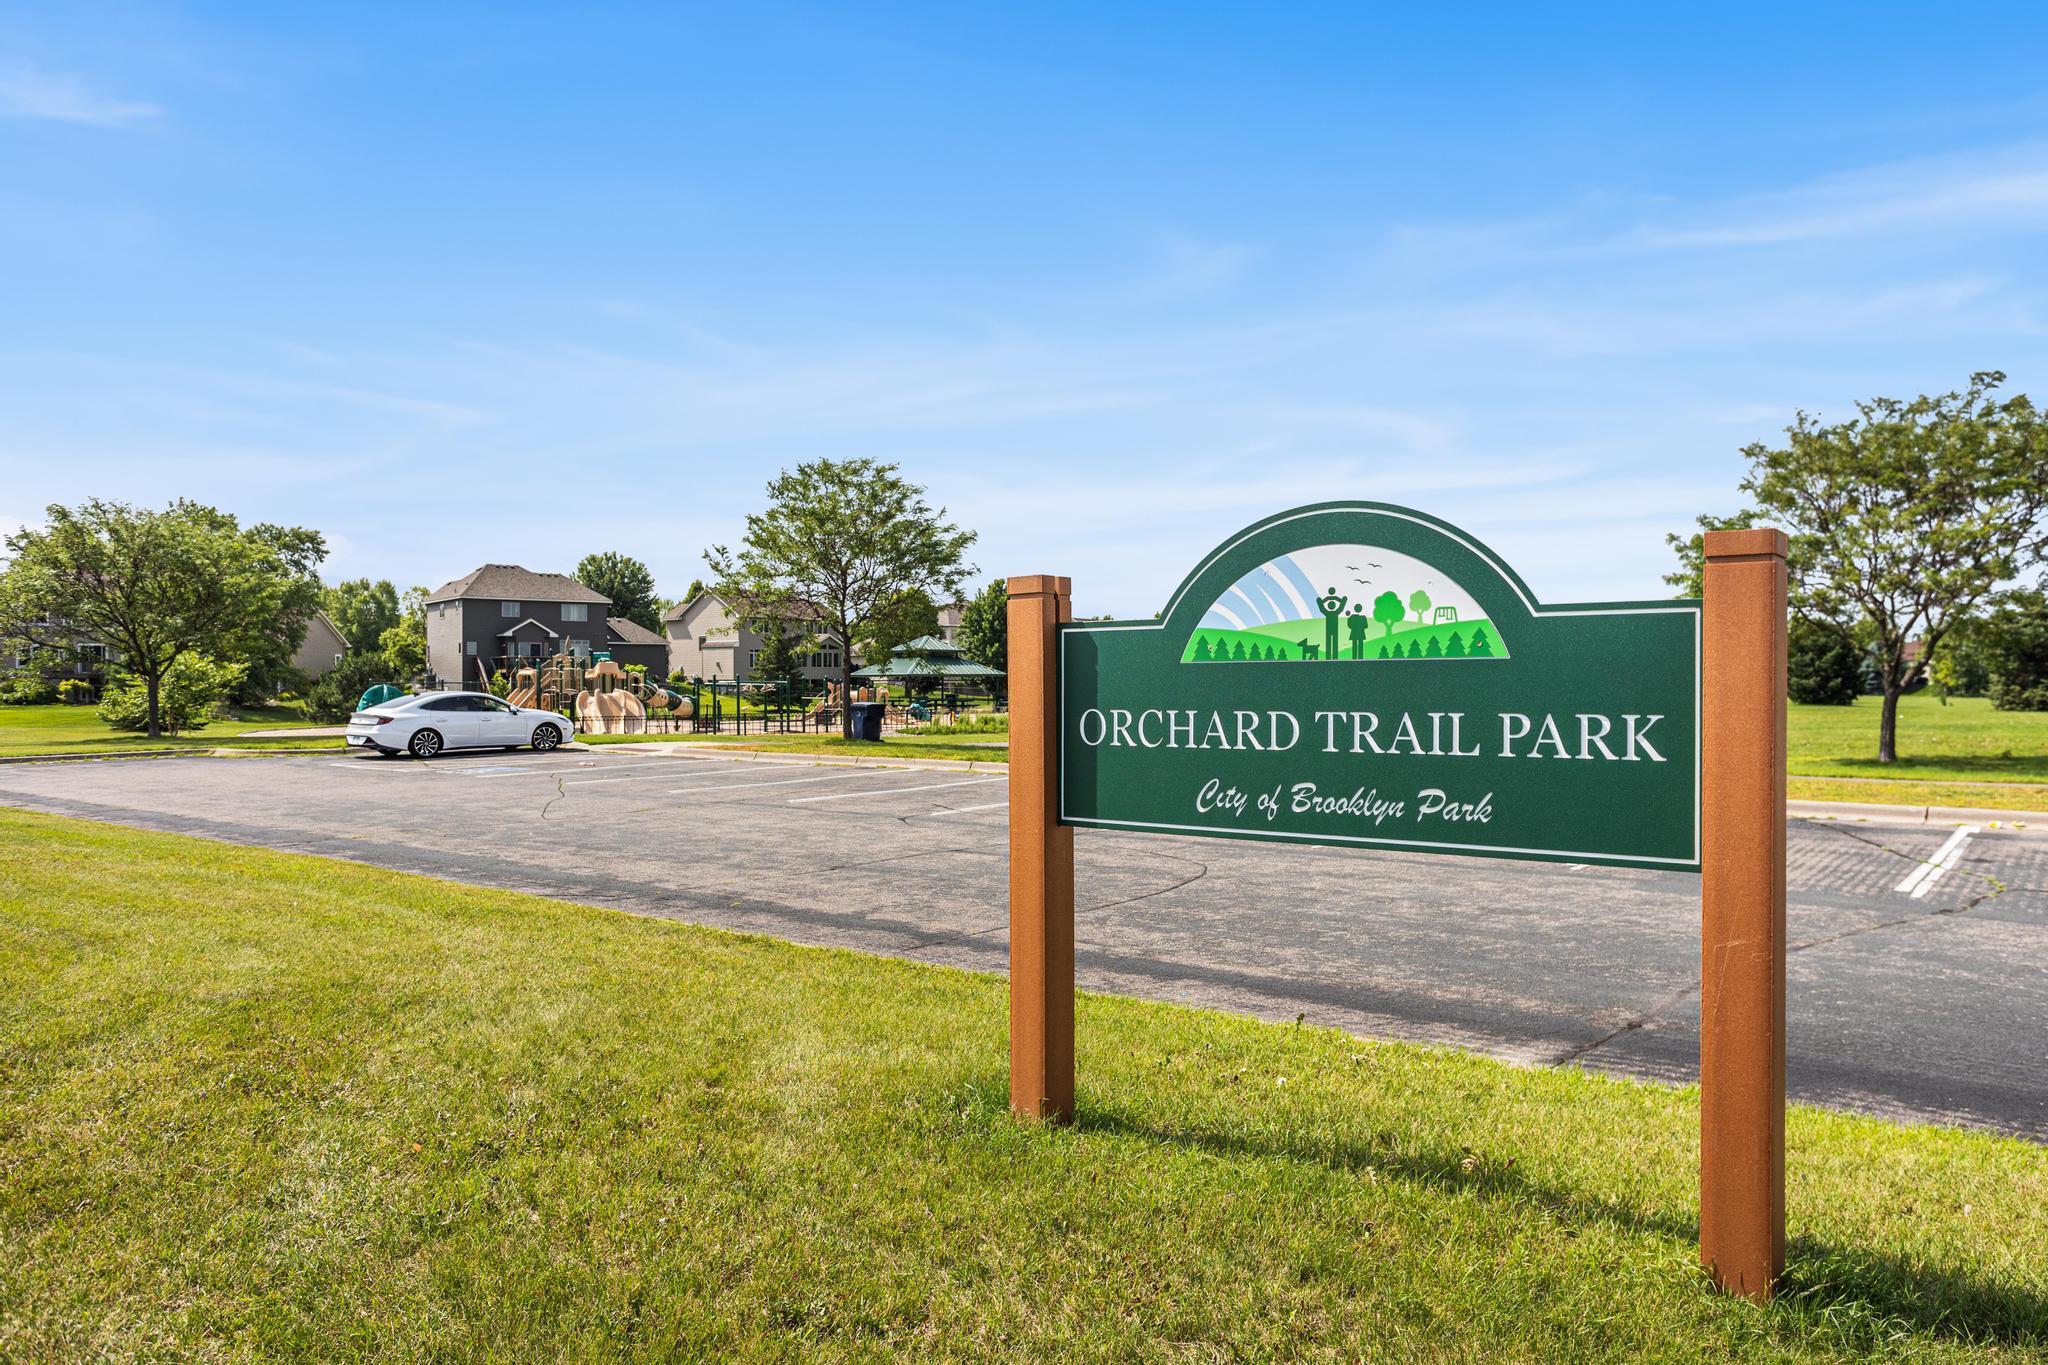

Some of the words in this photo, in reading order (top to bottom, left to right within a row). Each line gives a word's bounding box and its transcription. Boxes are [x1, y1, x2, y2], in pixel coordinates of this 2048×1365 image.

[1079, 708, 1301, 751] ORCHARD
[1314, 710, 1481, 757] TRAIL
[1497, 712, 1668, 762] PARK
[1195, 777, 1248, 817] City
[1257, 784, 1282, 822] of
[1290, 782, 1405, 826] Brooklyn
[1417, 787, 1494, 824] Park
